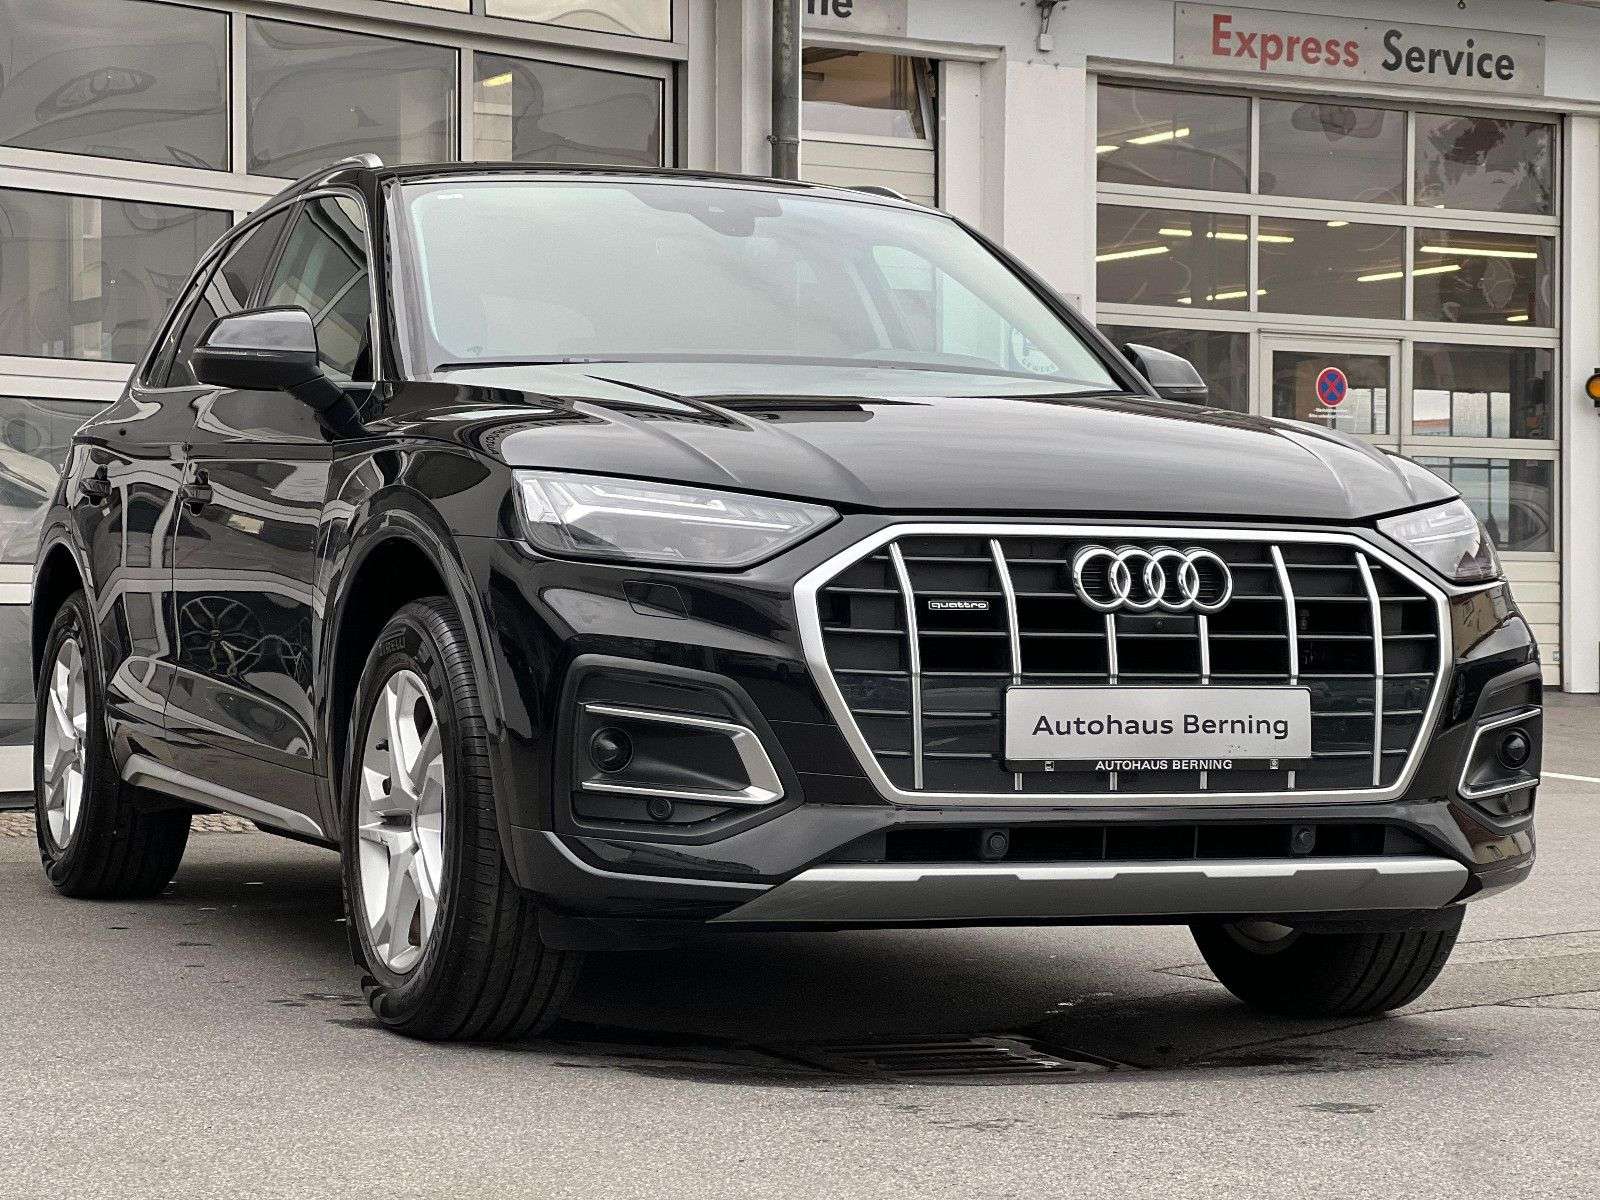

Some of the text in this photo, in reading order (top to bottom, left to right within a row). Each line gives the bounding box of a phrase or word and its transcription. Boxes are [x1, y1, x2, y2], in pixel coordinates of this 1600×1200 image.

[1212, 13, 1515, 81] Express Service
[1032, 714, 1290, 739] Autohaus Berning
[1095, 760, 1233, 771] AUTOHAUS BERNING
